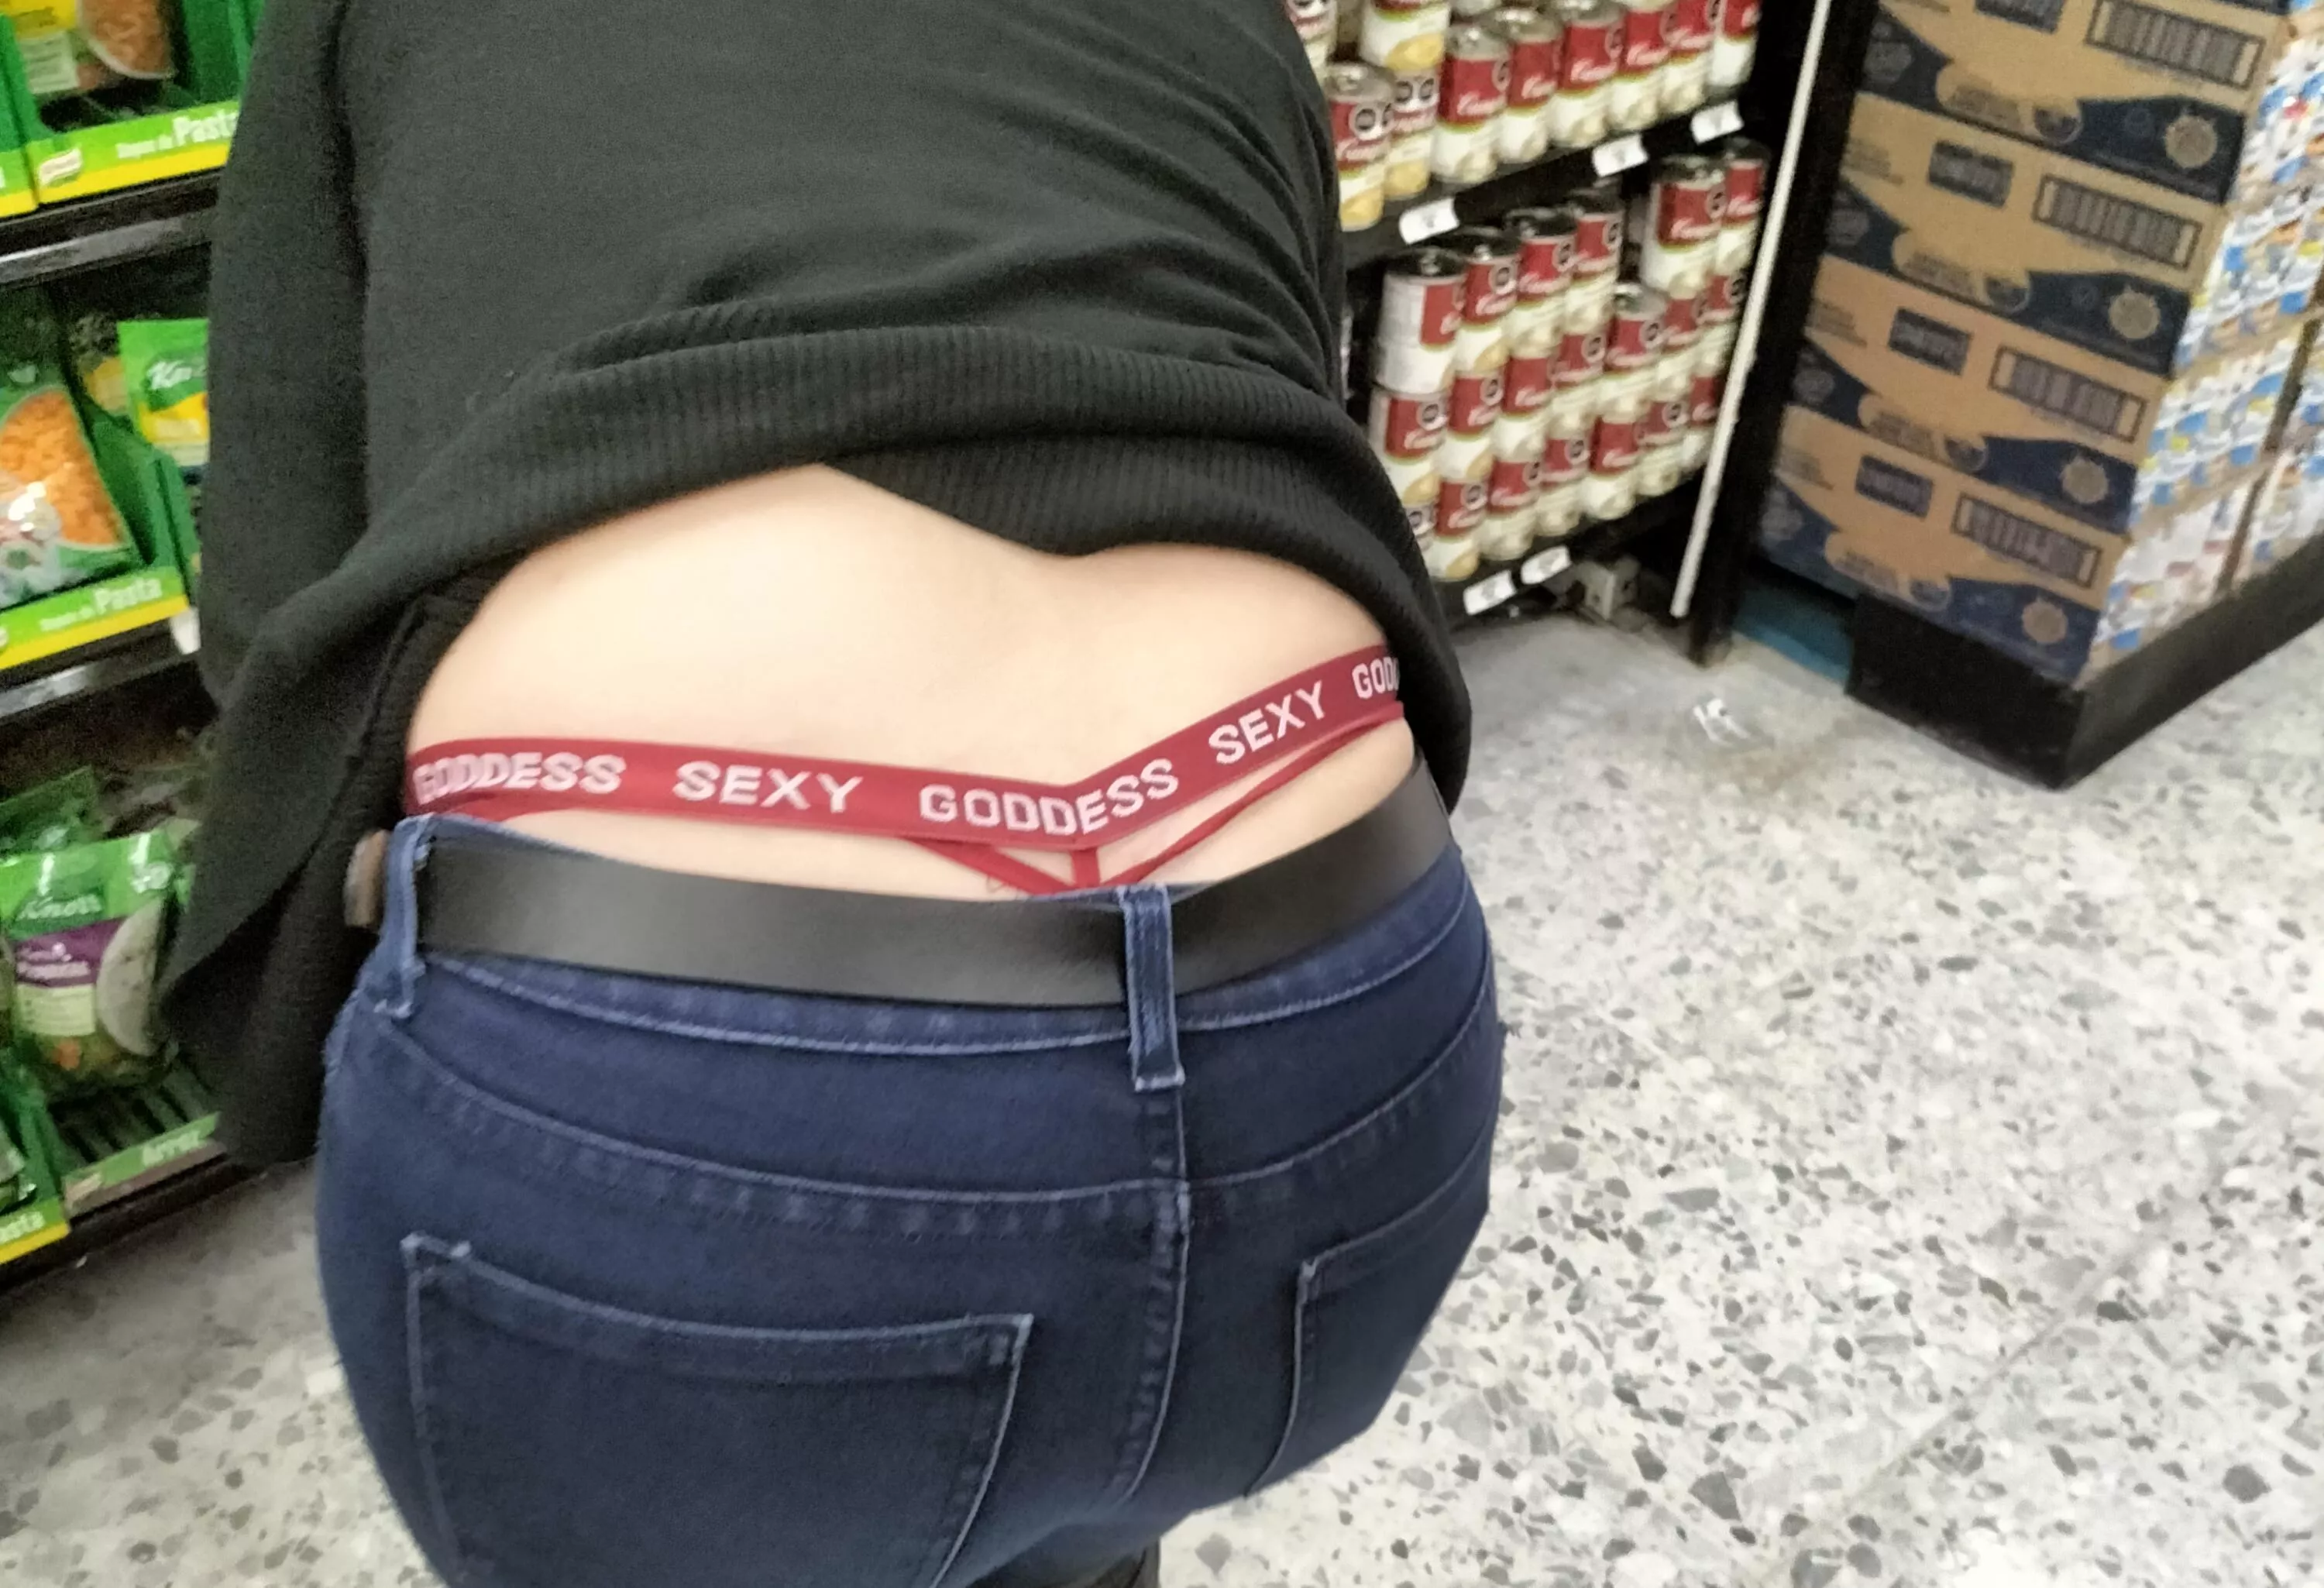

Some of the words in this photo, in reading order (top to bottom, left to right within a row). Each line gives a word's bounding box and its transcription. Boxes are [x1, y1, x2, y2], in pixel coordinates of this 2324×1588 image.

[412, 751, 627, 806] GODDESS
[672, 761, 863, 813] SEXY
[920, 758, 1179, 835] GODDESS
[1208, 681, 1327, 765] SEXY
